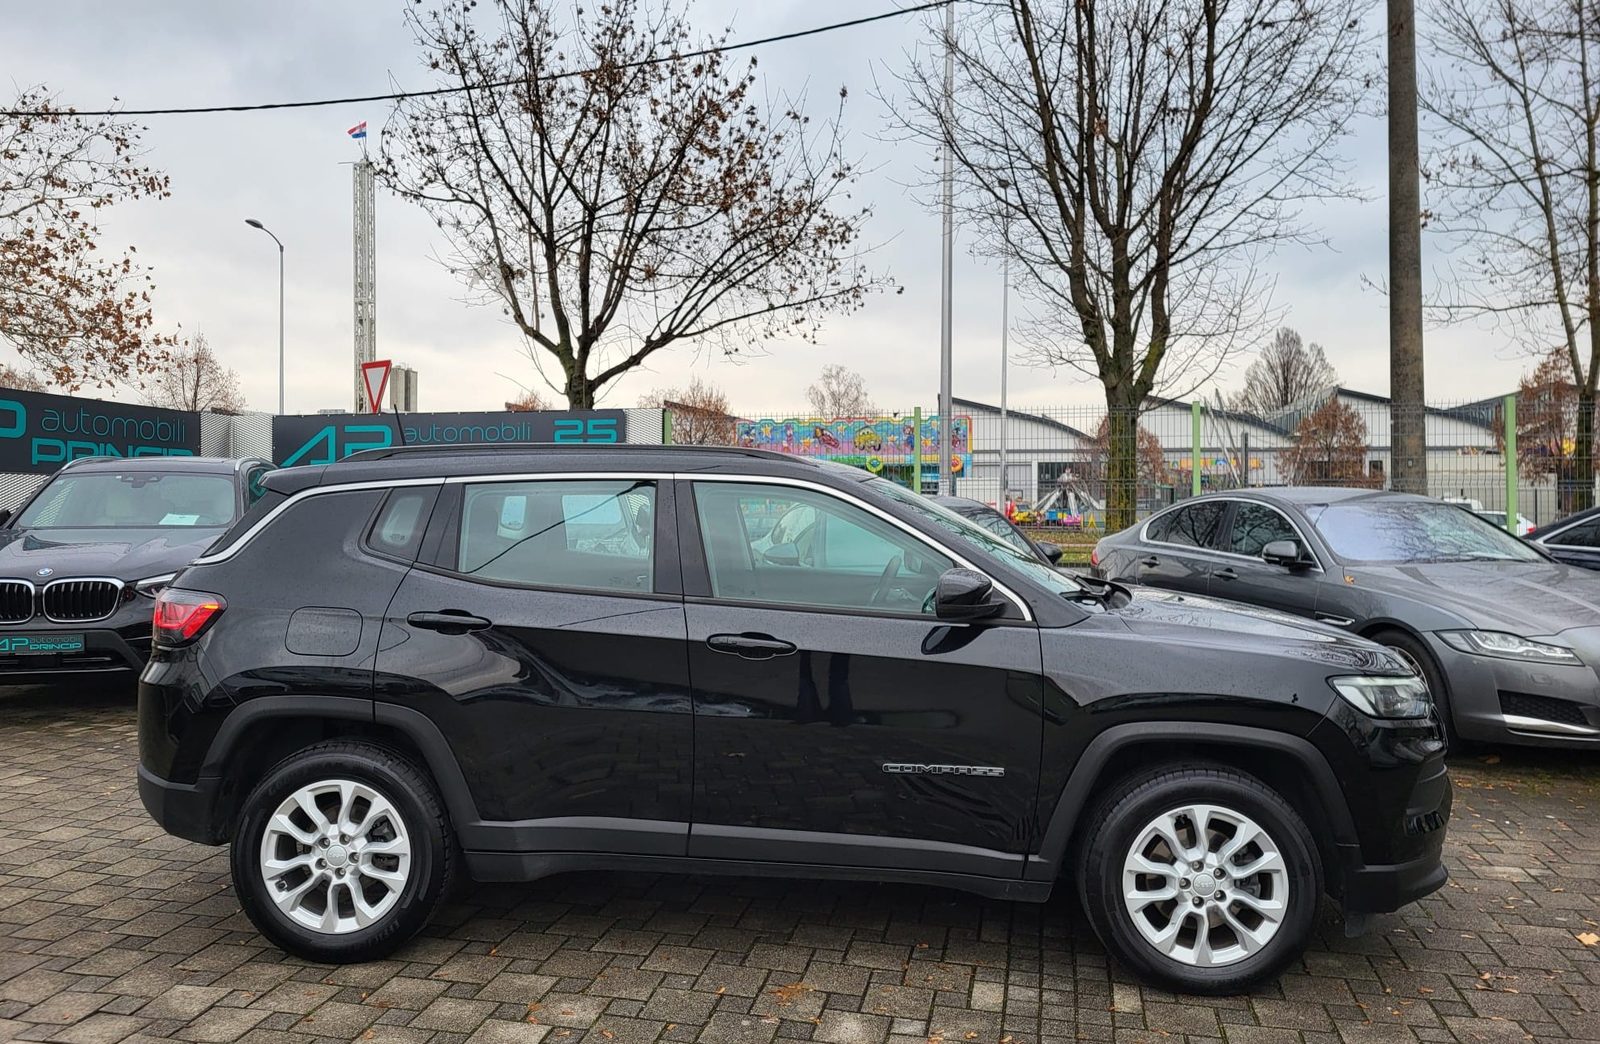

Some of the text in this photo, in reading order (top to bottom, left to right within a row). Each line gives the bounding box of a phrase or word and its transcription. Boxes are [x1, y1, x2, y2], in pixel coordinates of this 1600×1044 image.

[41, 407, 185, 443] automobili
[404, 422, 531, 443] automobili
[554, 419, 617, 443] 25
[882, 763, 1005, 777] COMPASS
